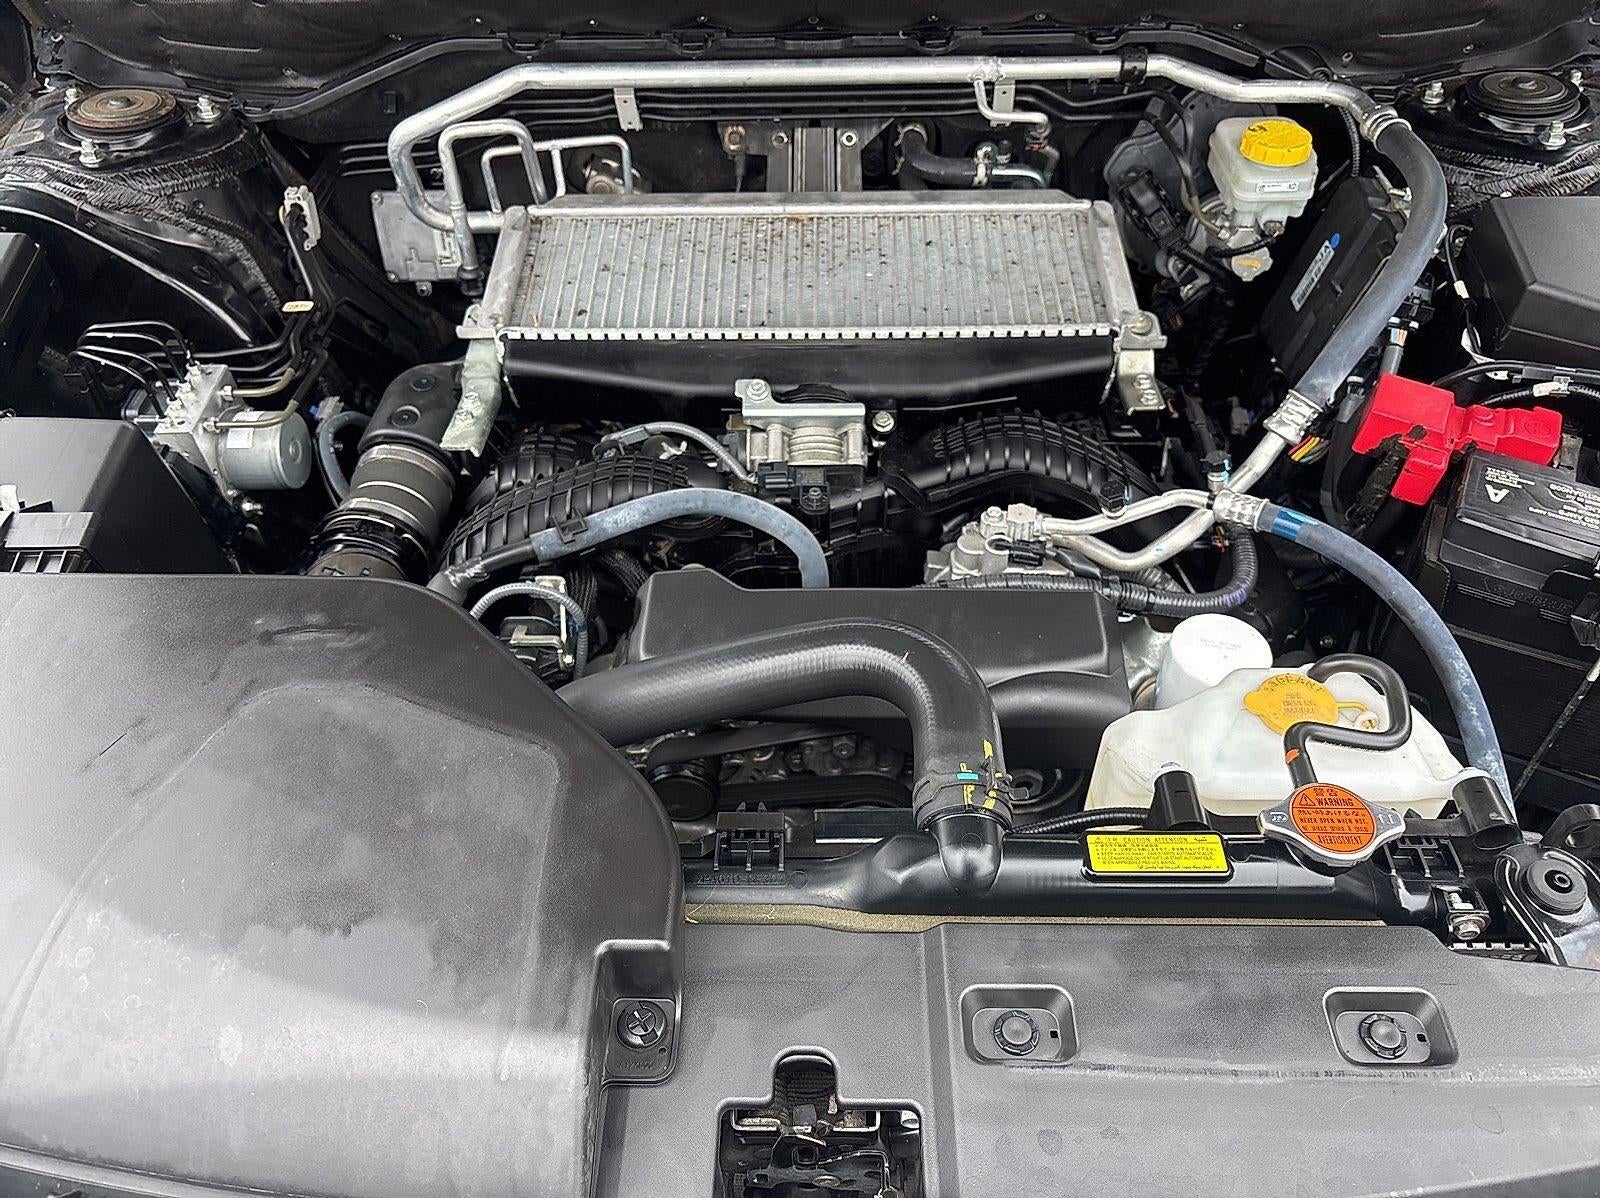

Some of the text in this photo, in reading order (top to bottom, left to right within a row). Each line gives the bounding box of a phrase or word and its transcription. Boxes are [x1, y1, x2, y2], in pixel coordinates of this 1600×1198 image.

[1485, 484, 1510, 503] A
[1316, 797, 1354, 807] WARNING
[1317, 835, 1363, 845] AVERTISSEMENT
